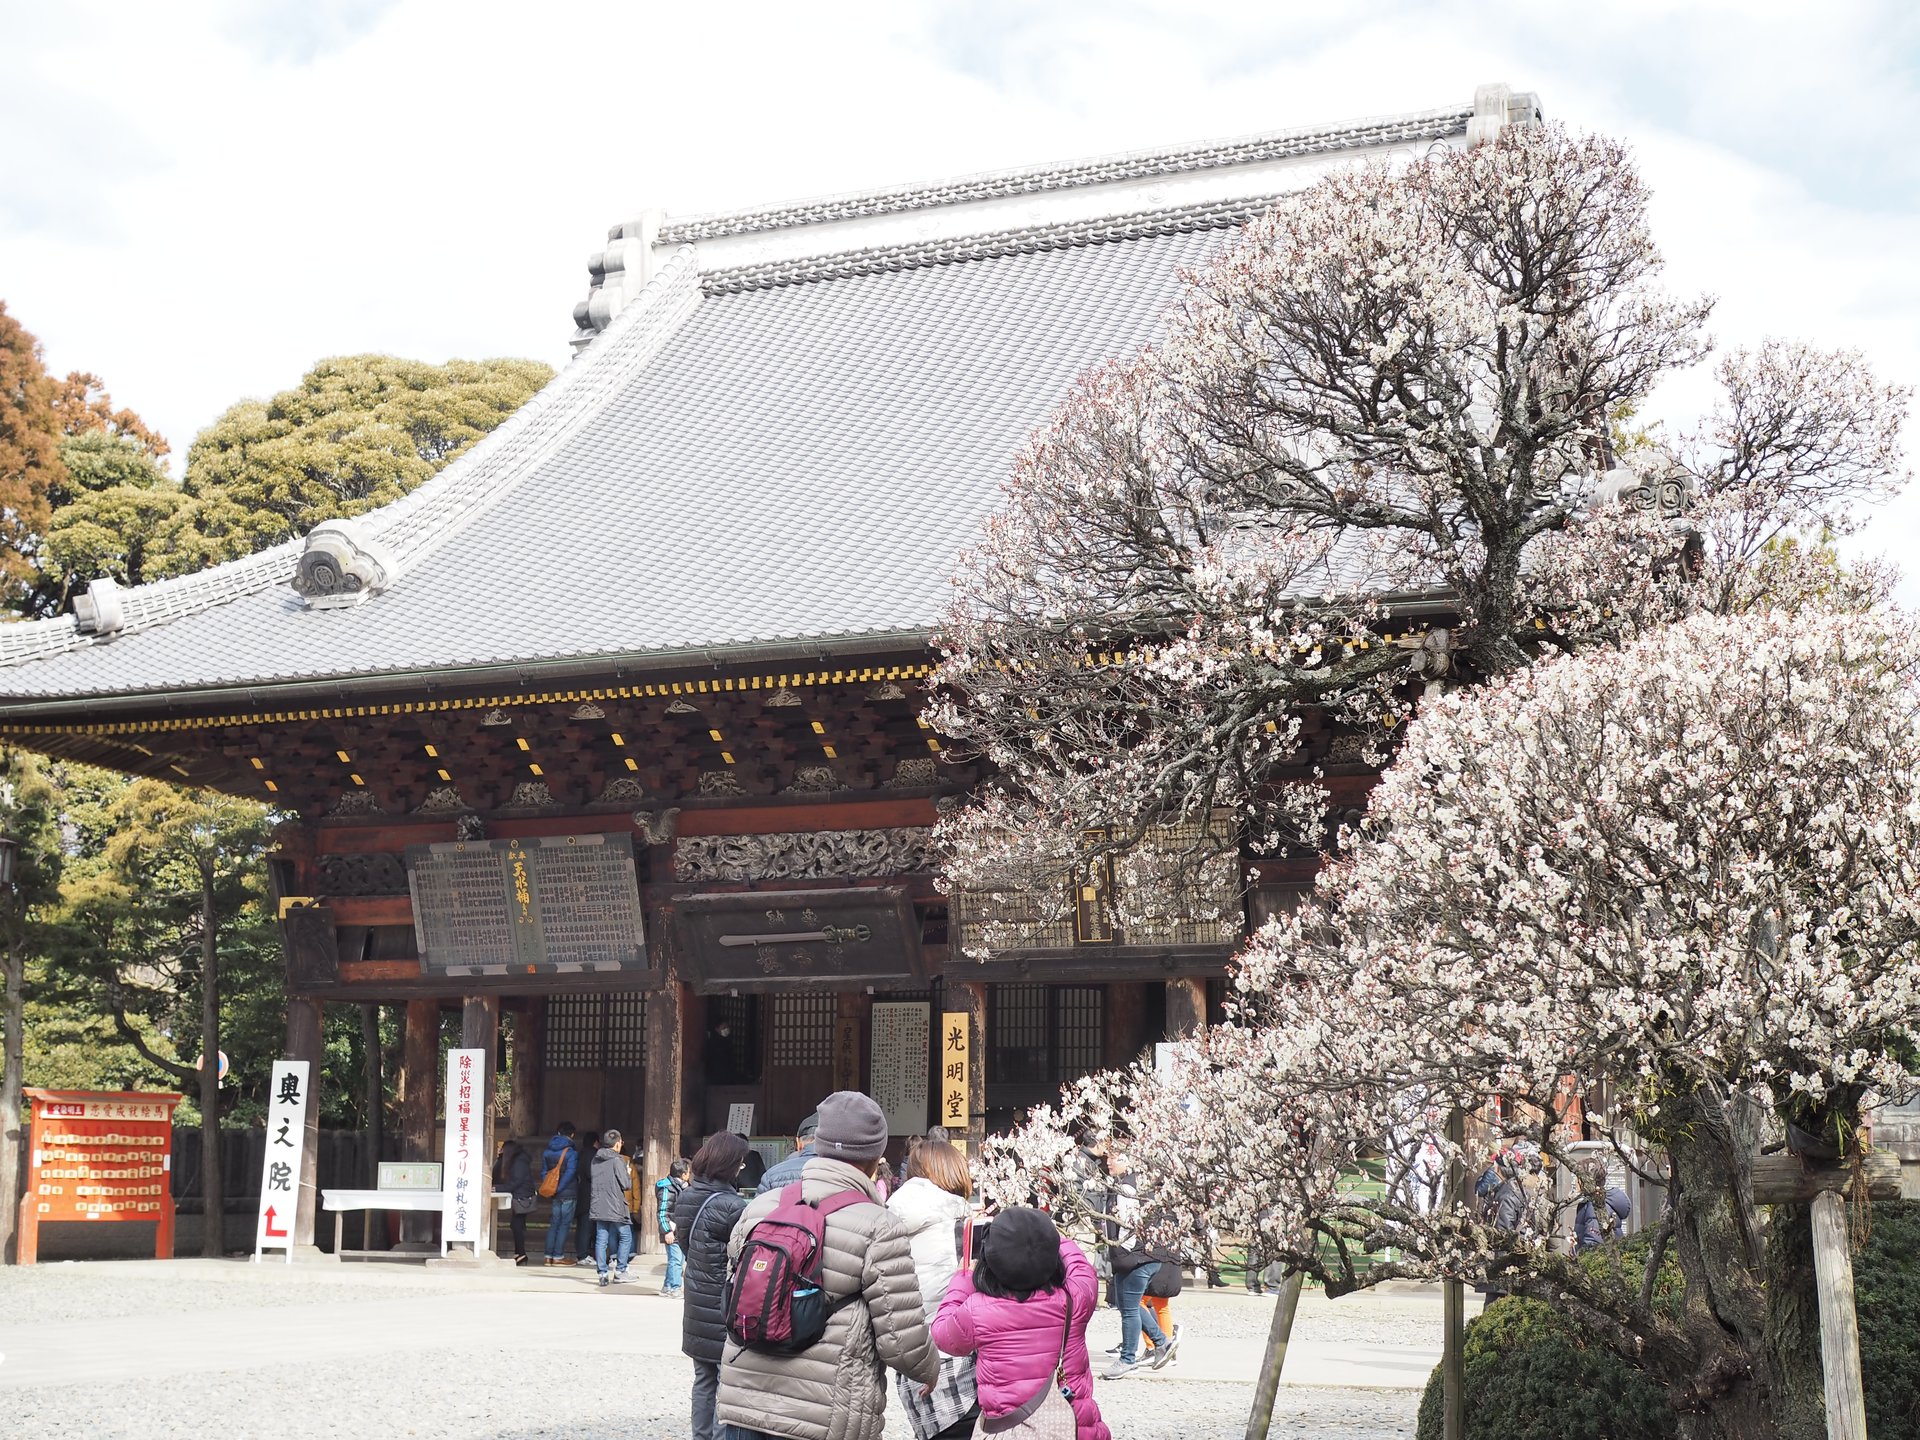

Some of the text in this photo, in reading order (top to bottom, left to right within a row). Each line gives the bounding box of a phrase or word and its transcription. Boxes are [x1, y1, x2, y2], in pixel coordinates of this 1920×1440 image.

[512, 861, 530, 904] 天水桶
[946, 1026, 965, 1118] 光明堂
[90, 1103, 163, 1118] 恋愛成就絵馬
[269, 1072, 300, 1191] 奥之院
